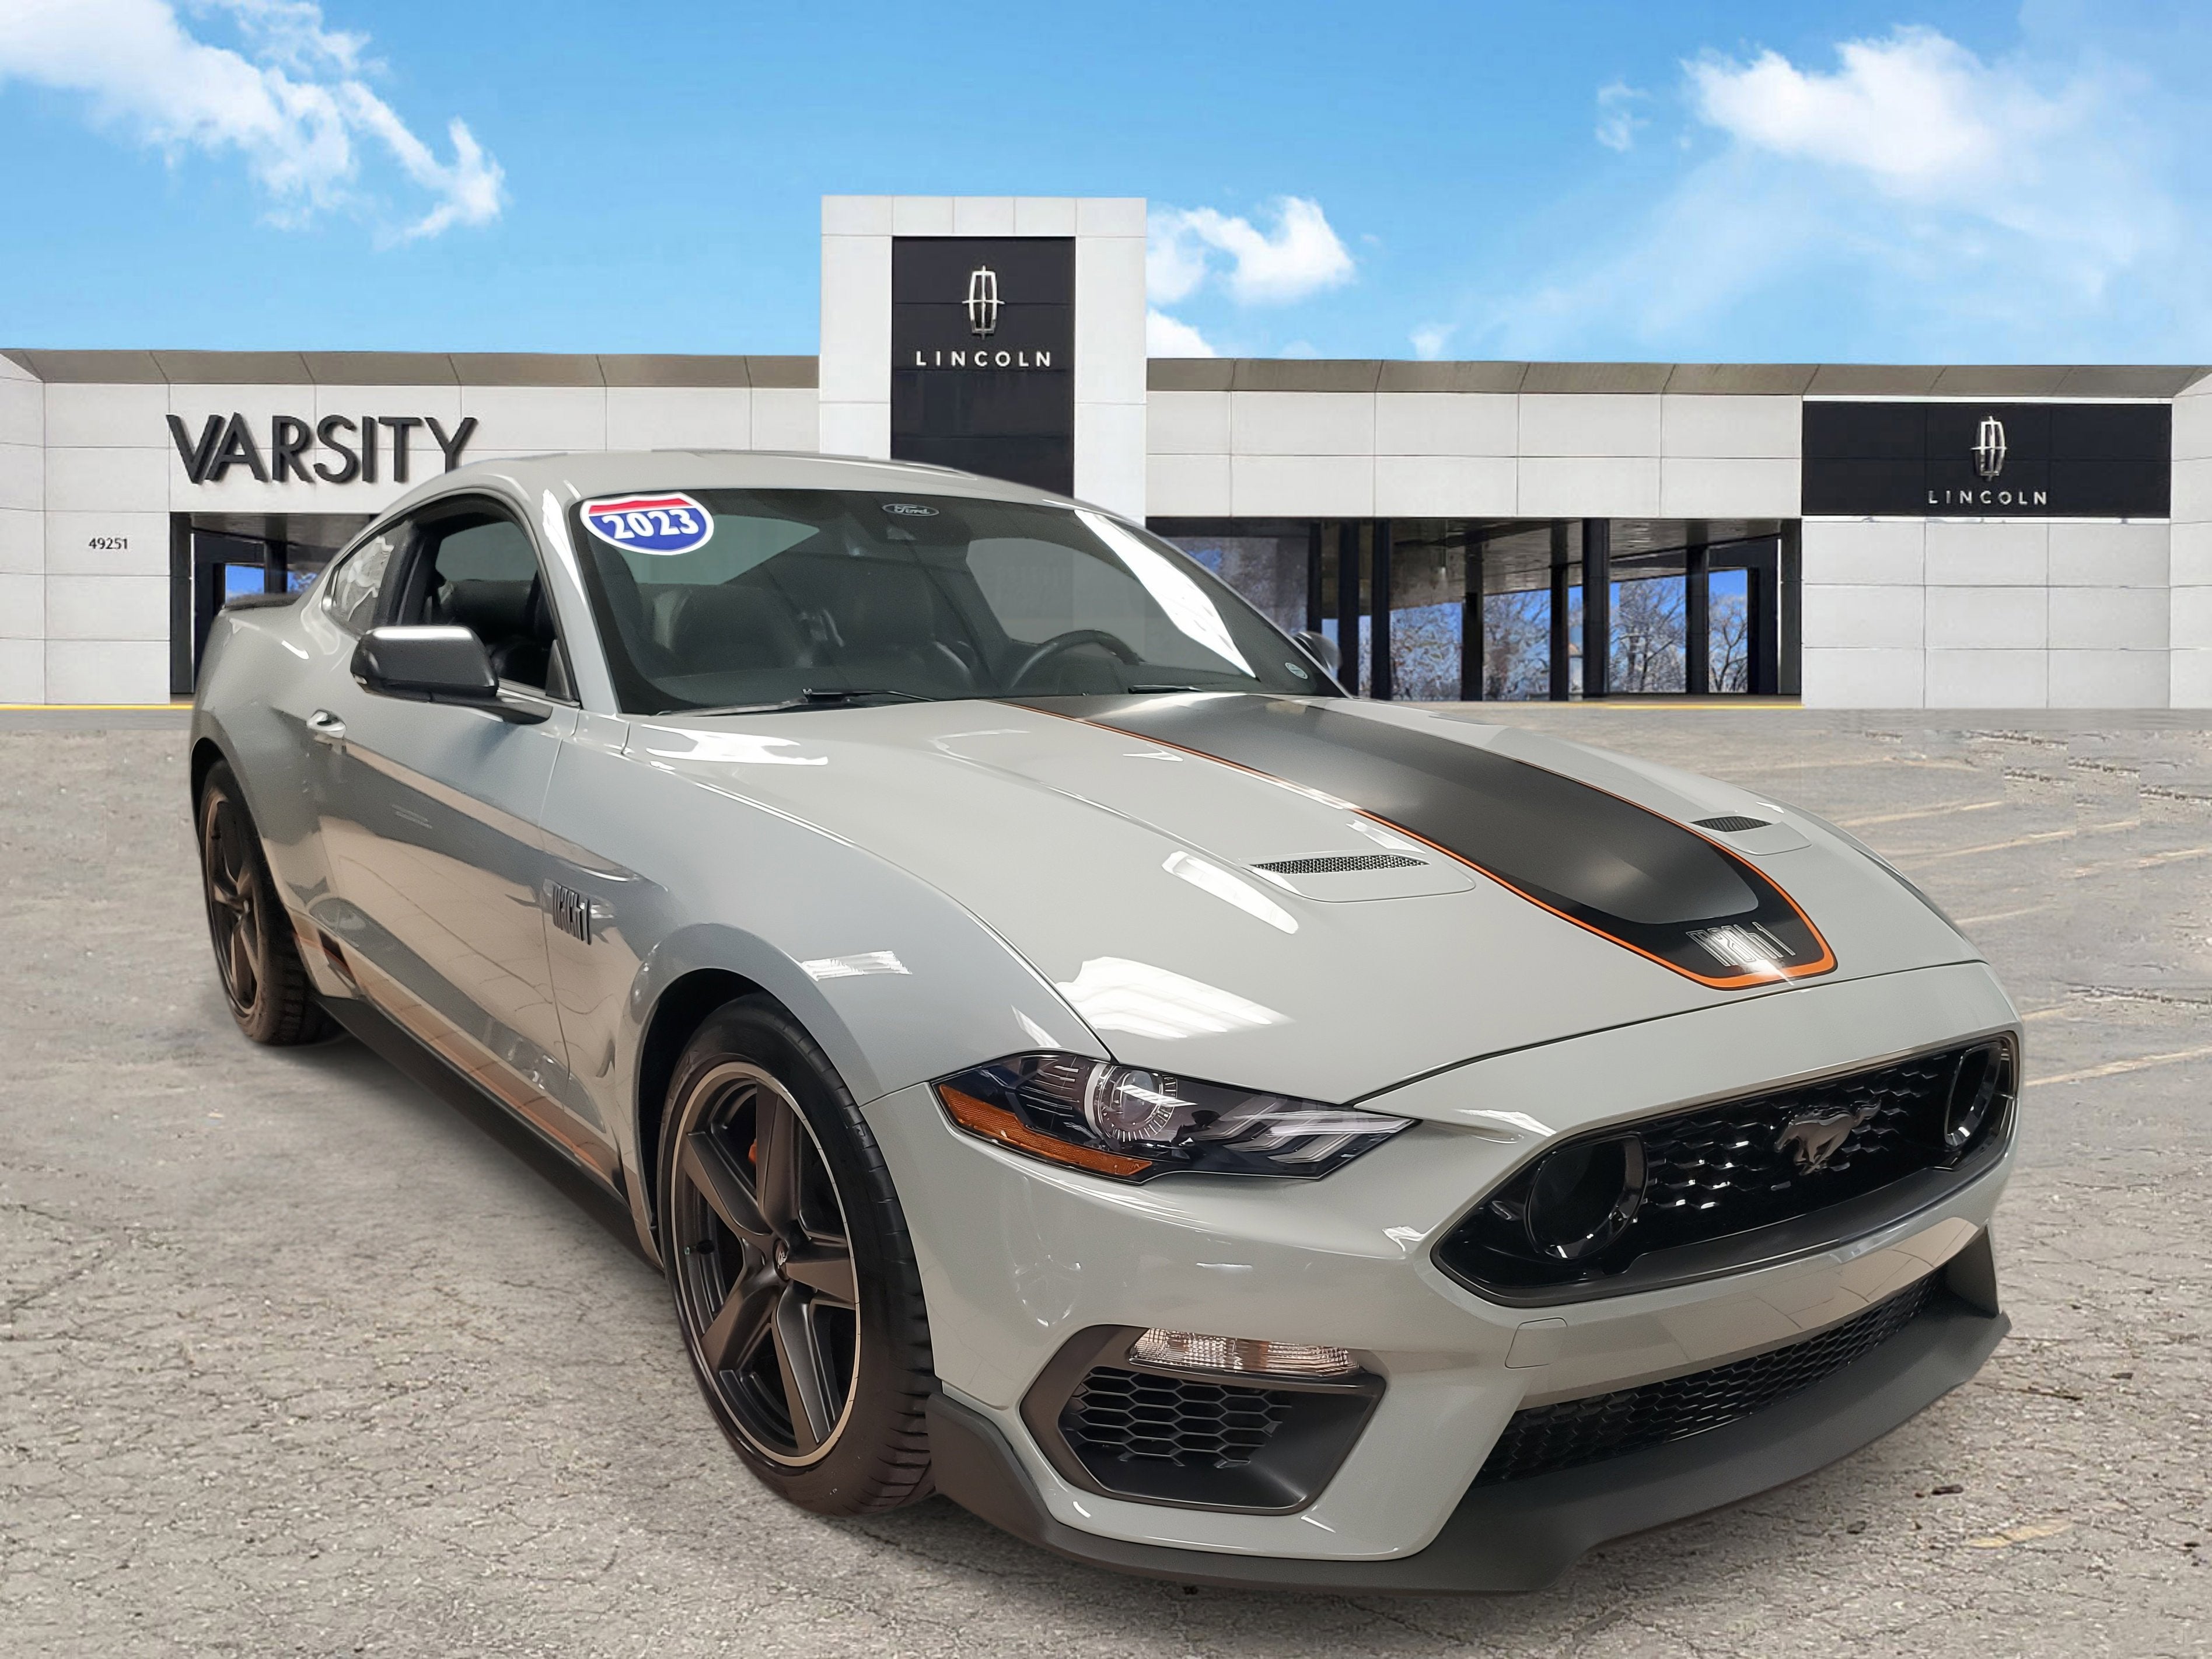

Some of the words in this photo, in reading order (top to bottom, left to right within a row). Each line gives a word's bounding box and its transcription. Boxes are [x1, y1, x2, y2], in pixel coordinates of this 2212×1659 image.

[915, 351, 1051, 367] LINCOLN
[166, 411, 478, 485] VARSITY
[1928, 490, 2047, 505] LINCOLN
[601, 509, 700, 539] 2023
[89, 537, 128, 549] 49251
